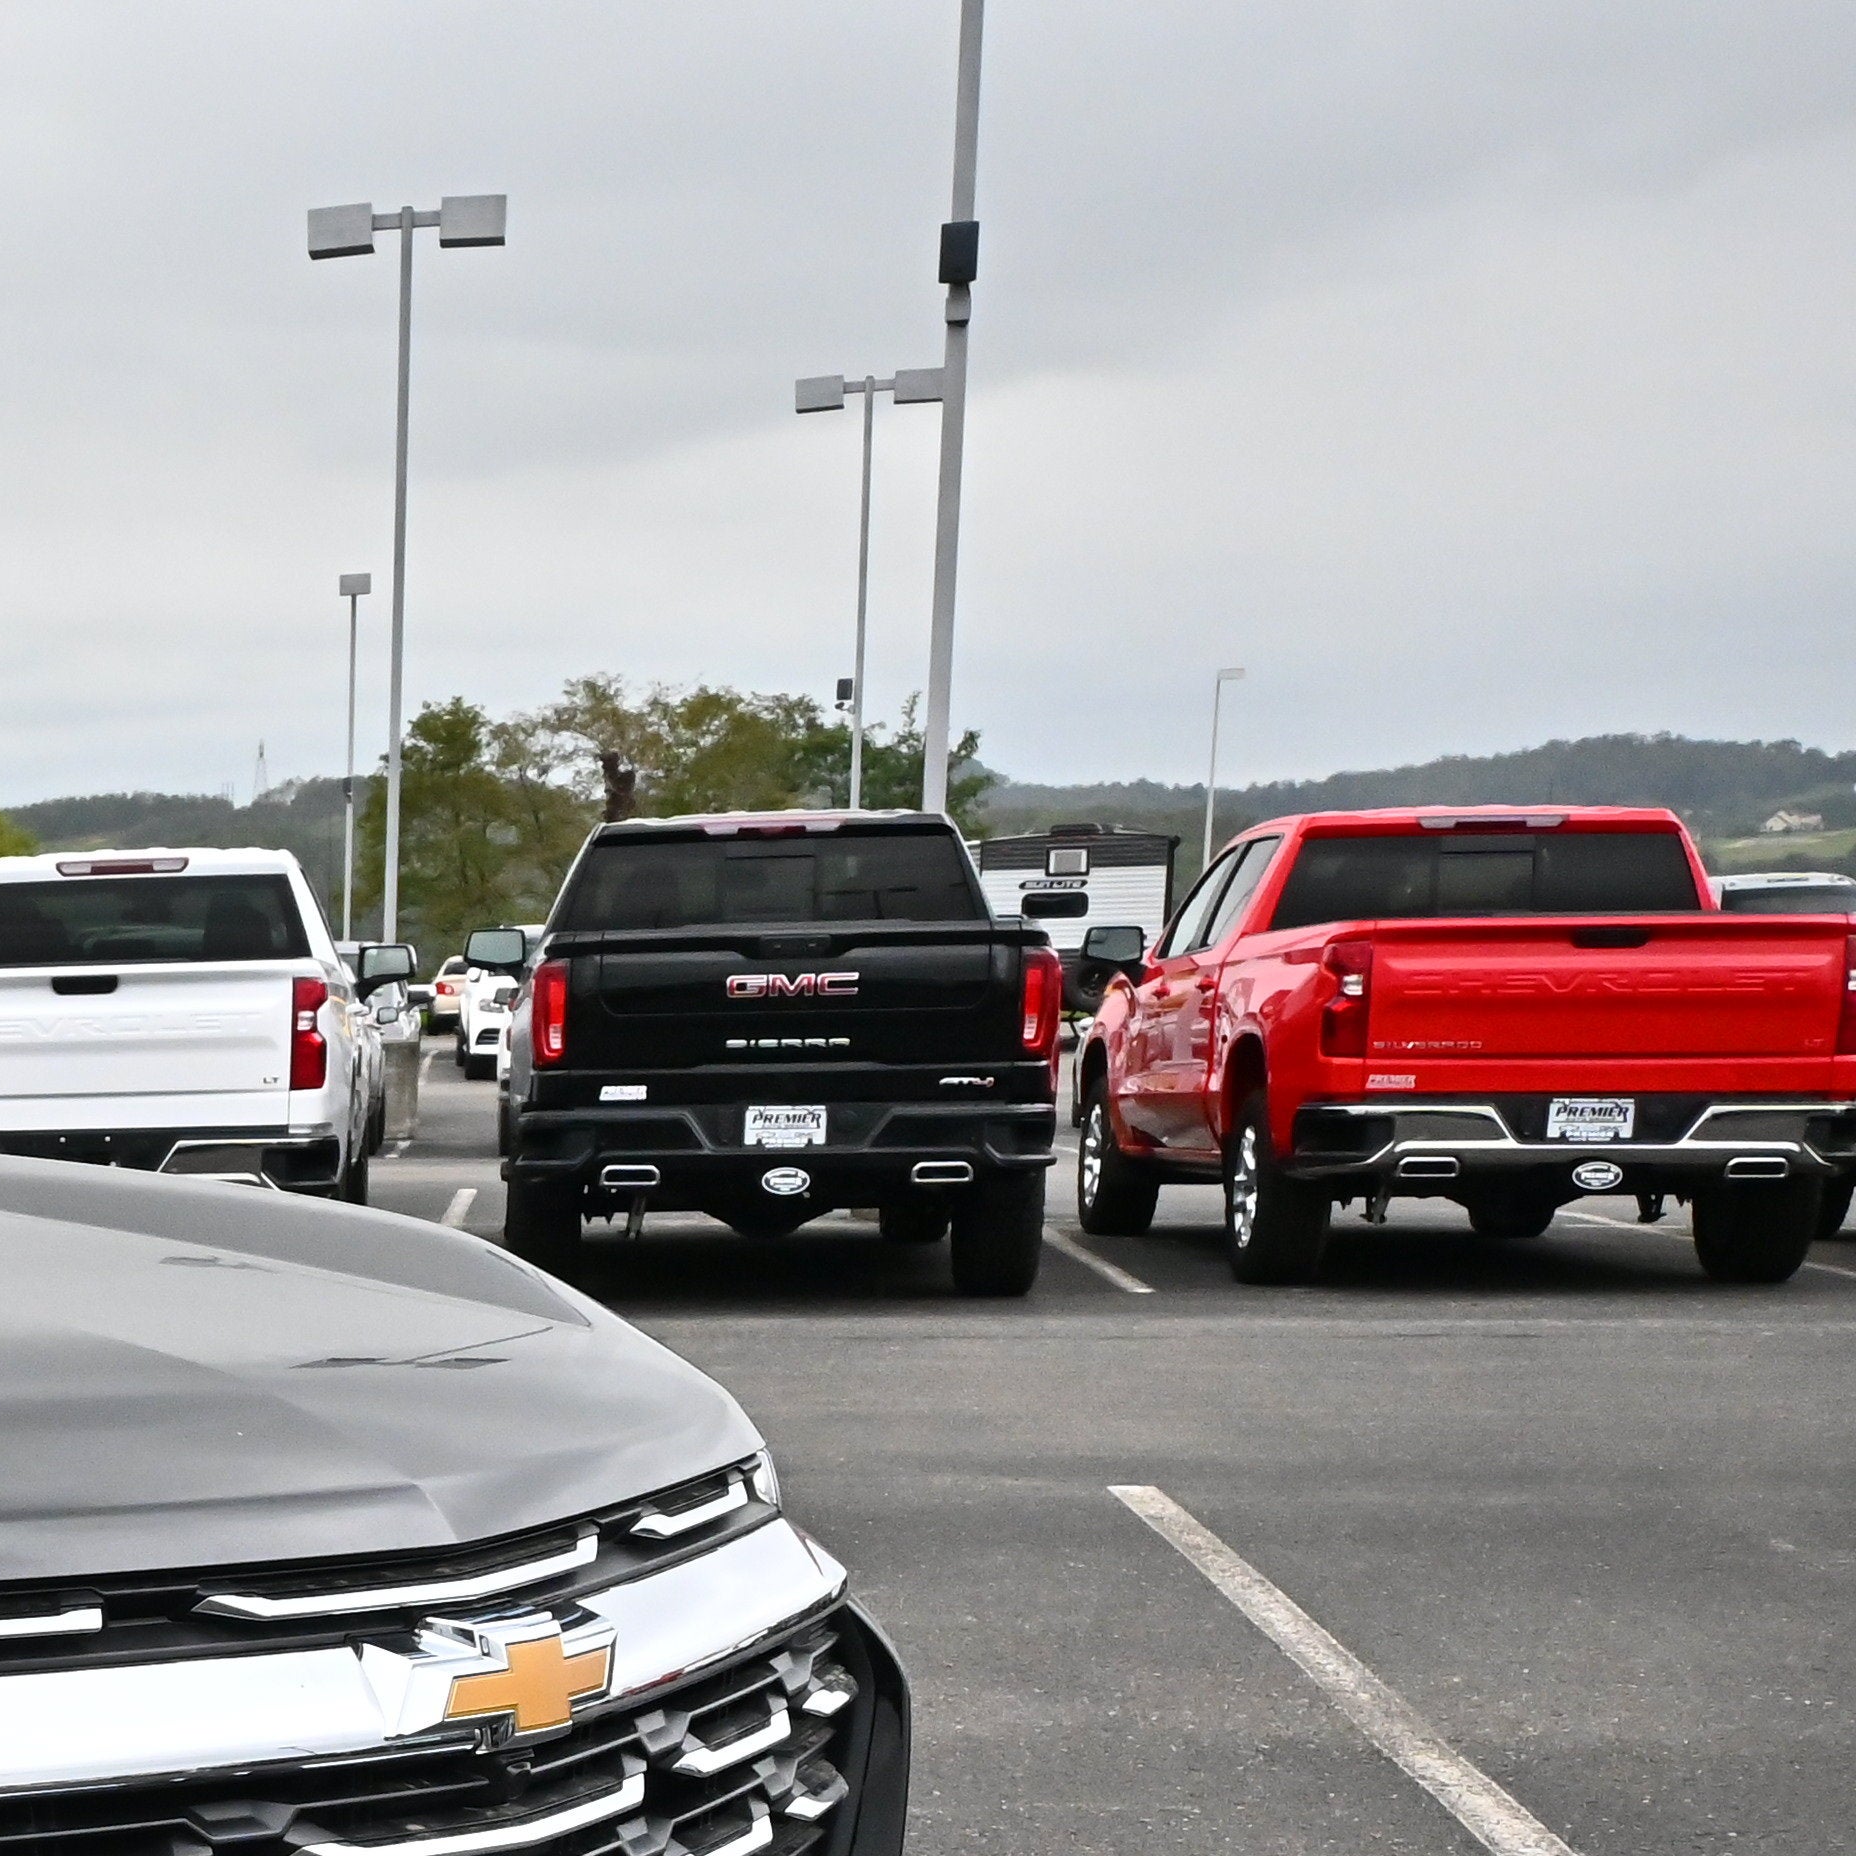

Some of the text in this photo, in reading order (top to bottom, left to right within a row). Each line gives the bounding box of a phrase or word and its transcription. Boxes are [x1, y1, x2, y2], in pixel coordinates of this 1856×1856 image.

[725, 971, 861, 999] GMC
[725, 1037, 851, 1049] SIERRA
[1372, 1040, 1483, 1050] SILVERADO
[262, 1076, 280, 1085] LT
[751, 1110, 822, 1129] PREMIER
[1555, 1102, 1630, 1123] PREMIER
